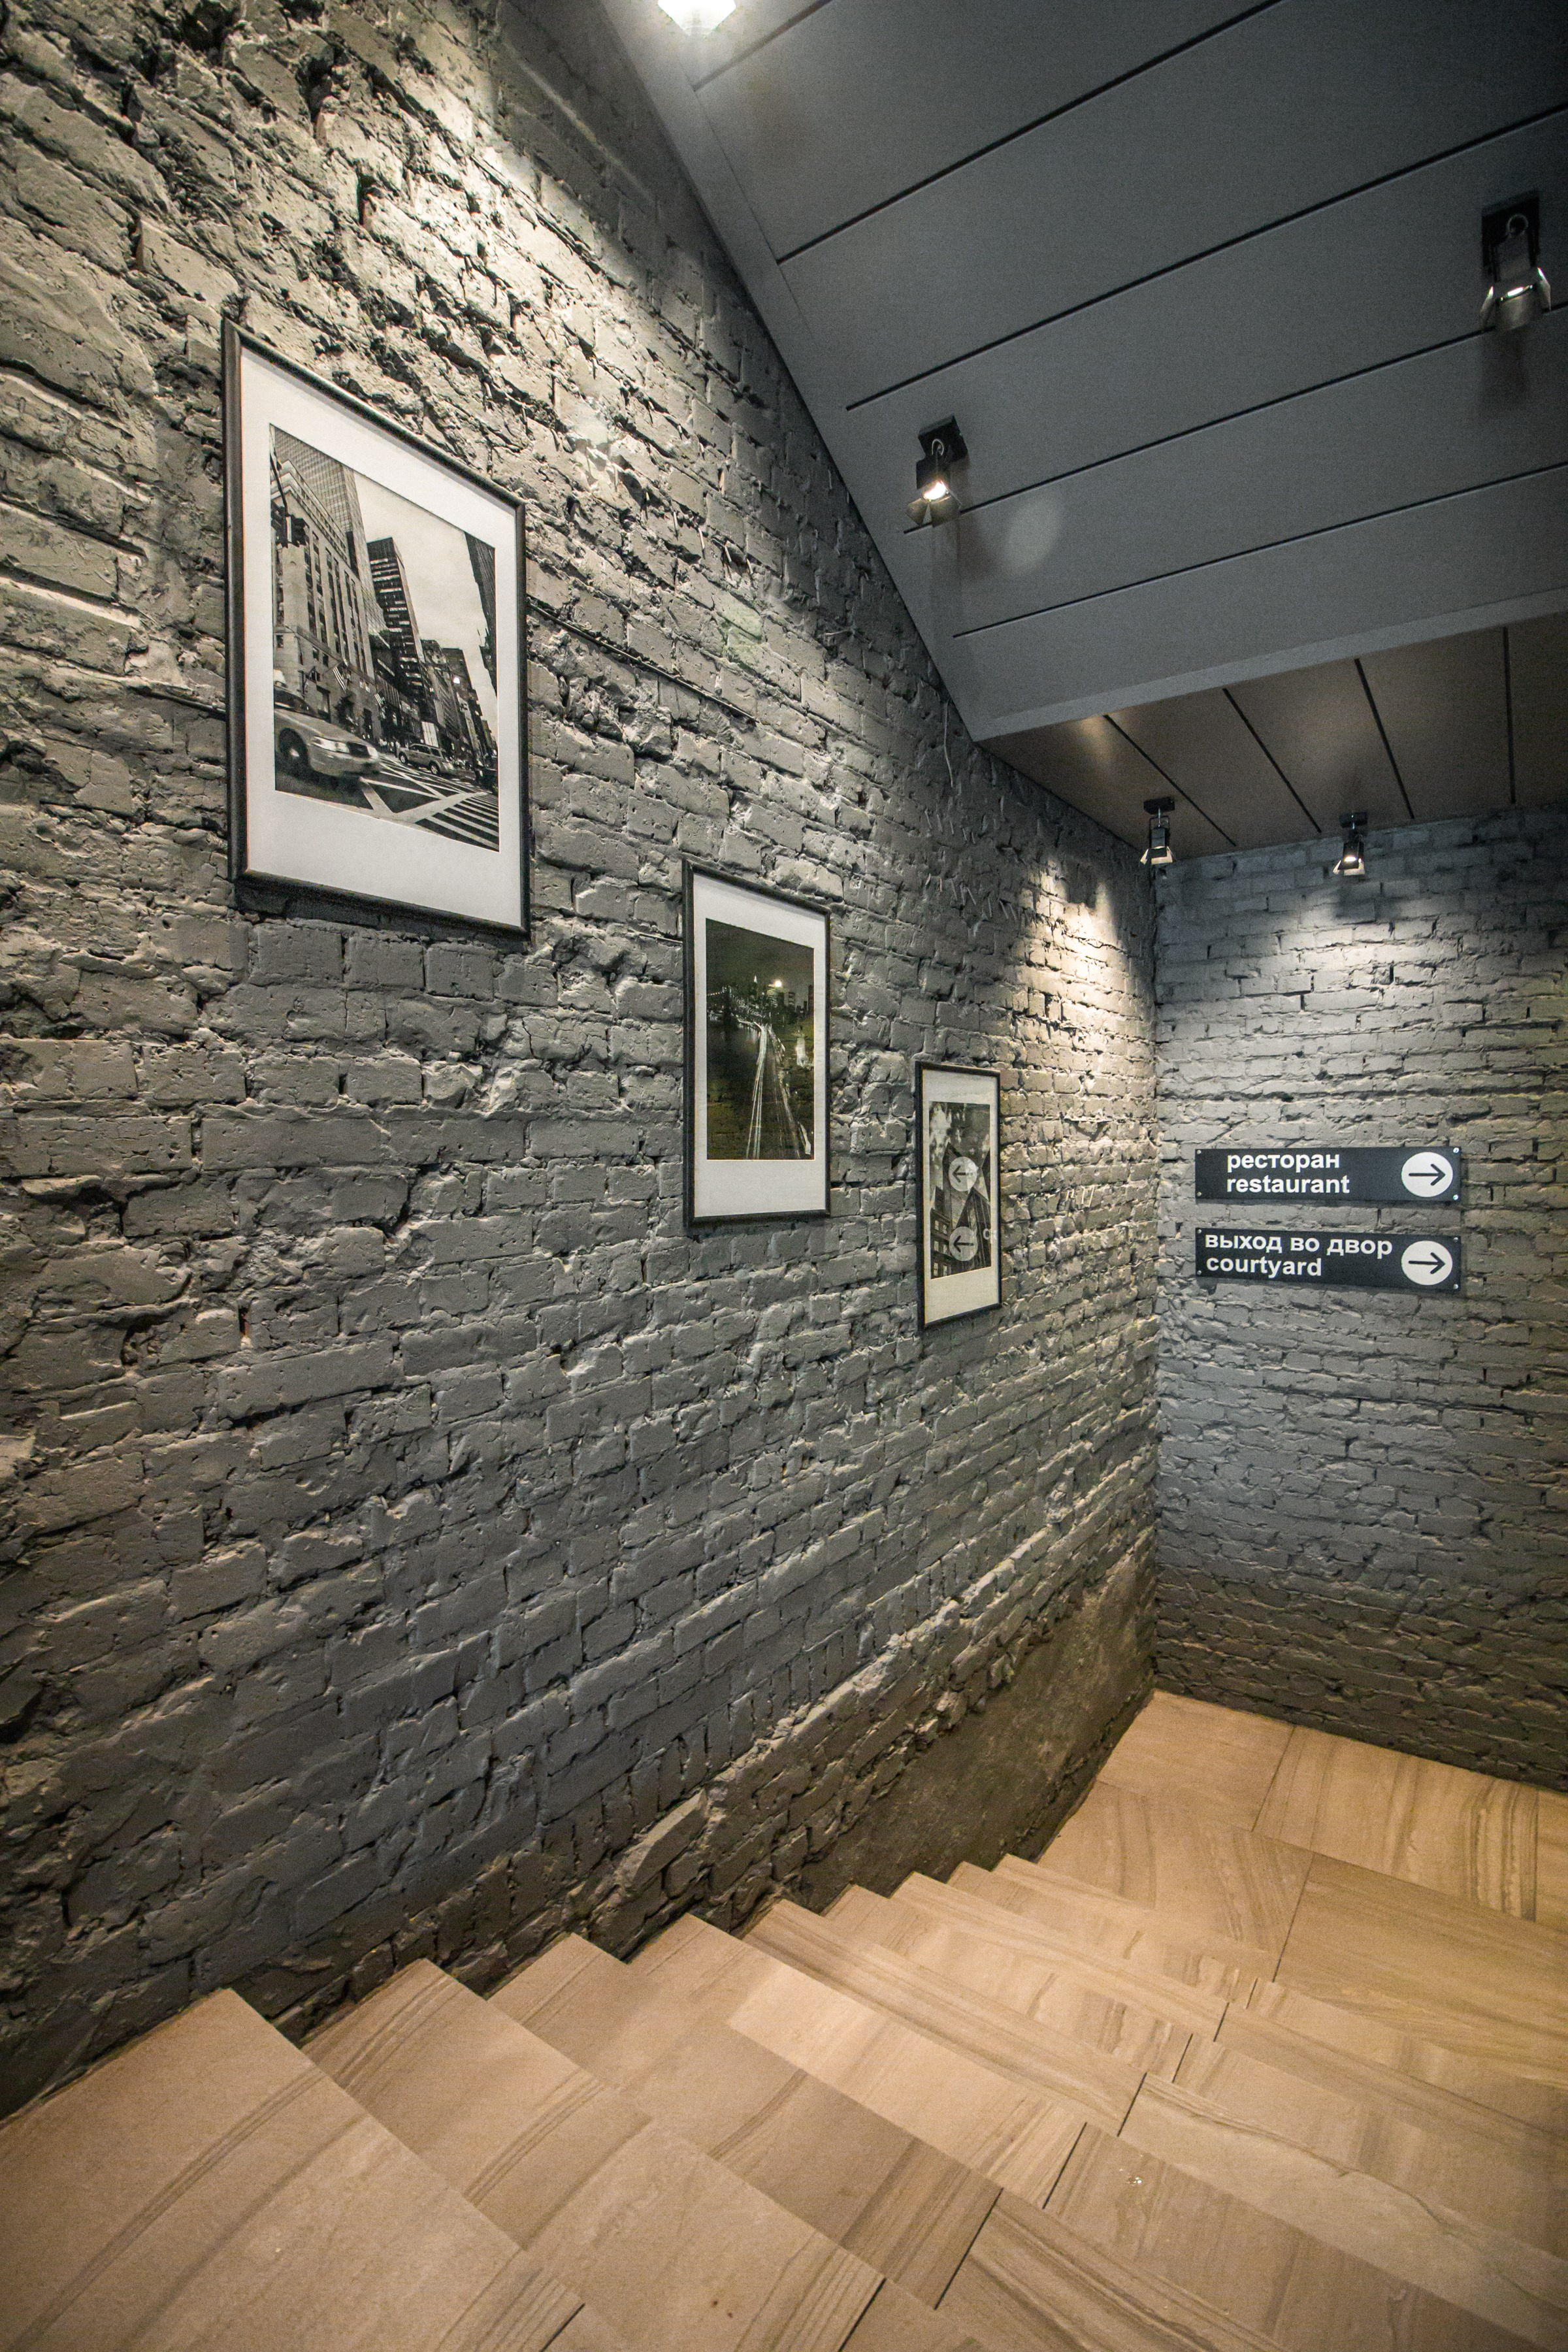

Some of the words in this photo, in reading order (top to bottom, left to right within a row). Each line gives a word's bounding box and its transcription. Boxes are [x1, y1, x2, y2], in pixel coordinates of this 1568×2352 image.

[1227, 1154, 1340, 1173] ресторан
[1226, 1175, 1350, 1194] restaurant
[1205, 1234, 1282, 1254] выход
[1290, 1237, 1320, 1252] во
[1326, 1238, 1393, 1260] двор
[1206, 1256, 1322, 1279] courtyard
